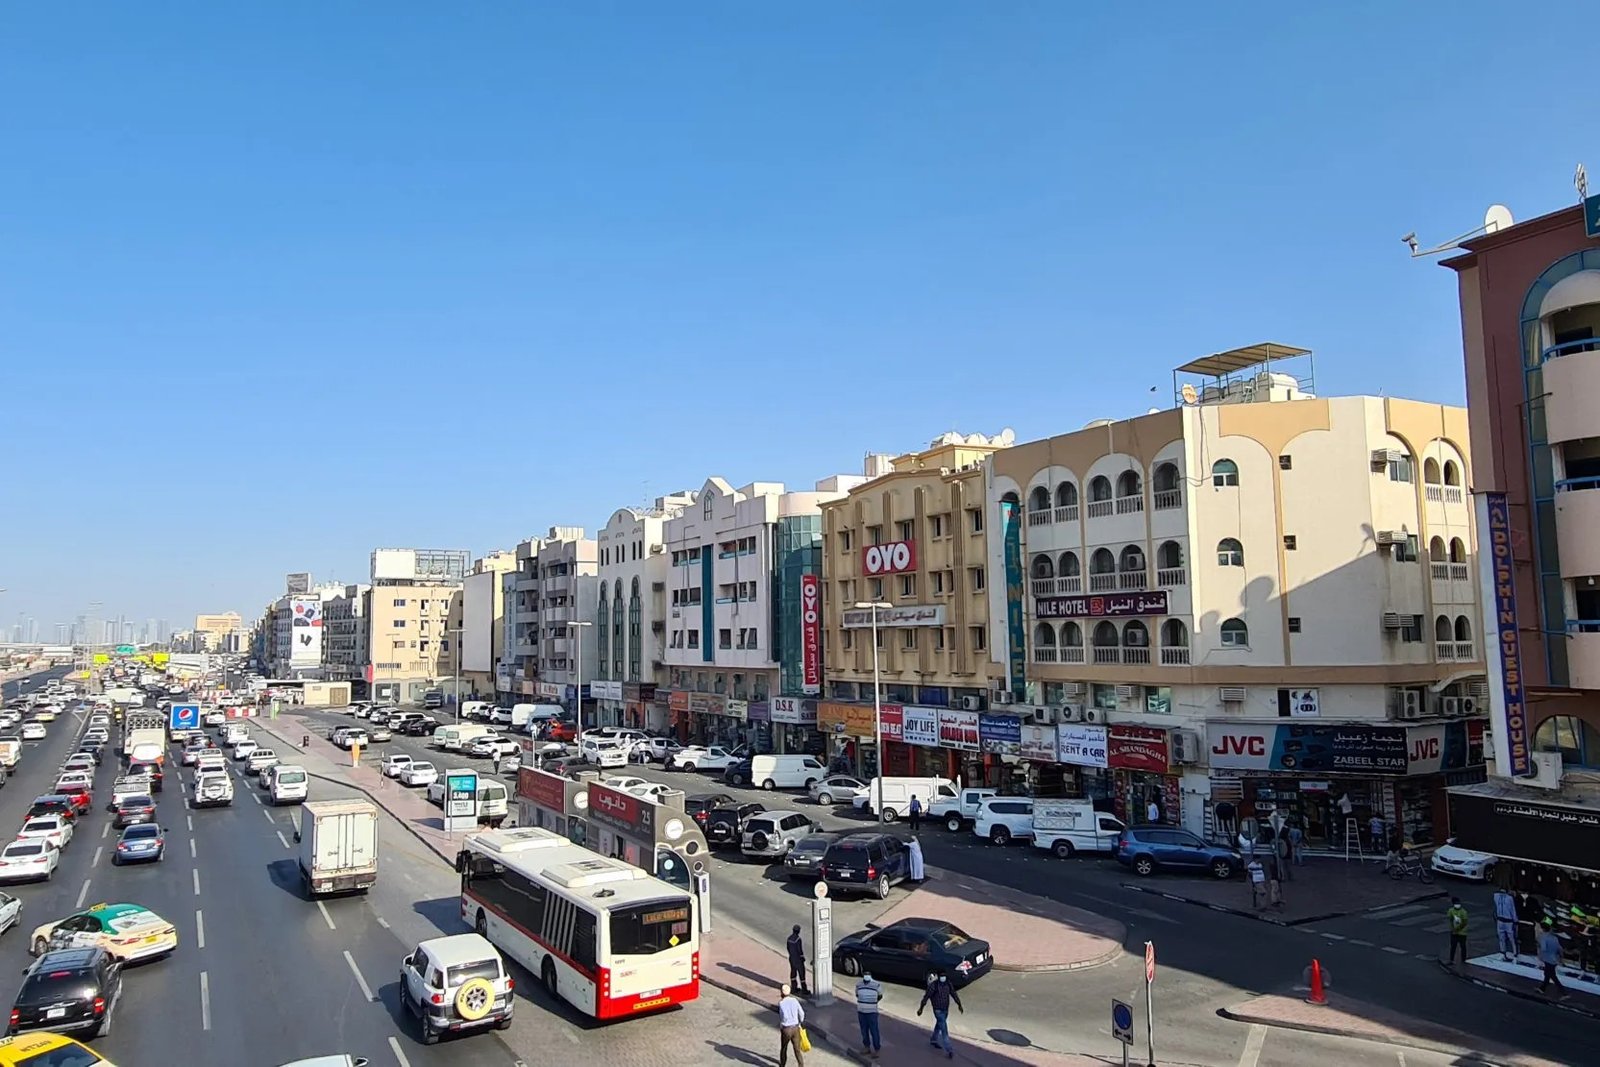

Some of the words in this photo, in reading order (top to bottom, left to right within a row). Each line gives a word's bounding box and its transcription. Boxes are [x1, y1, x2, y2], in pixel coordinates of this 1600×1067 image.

[866, 542, 910, 573] OYO
[804, 584, 817, 623] OYO
[1038, 601, 1057, 615] NILE
[1059, 599, 1088, 614] HOTEL
[1106, 599, 1134, 614] النيل
[1136, 594, 1165, 612] فندق
[1502, 629, 1520, 696] GUEST
[775, 700, 794, 712] D.S.K
[905, 720, 918, 731] JOY
[920, 721, 935, 733] LIFE
[1333, 732, 1368, 744] زعبيل
[1371, 732, 1403, 744] نجمة
[1508, 703, 1526, 770] HOUSE
[1061, 744, 1080, 756] RENT
[1082, 747, 1088, 756] A
[1090, 748, 1105, 758] CAR
[1212, 735, 1264, 756] JVC
[1410, 738, 1439, 762] JVC
[1119, 745, 1166, 763] SHANDAGHA
[1333, 756, 1375, 765] ZABEEL
[1377, 757, 1405, 766] STAR
[641, 809, 650, 824] 25
